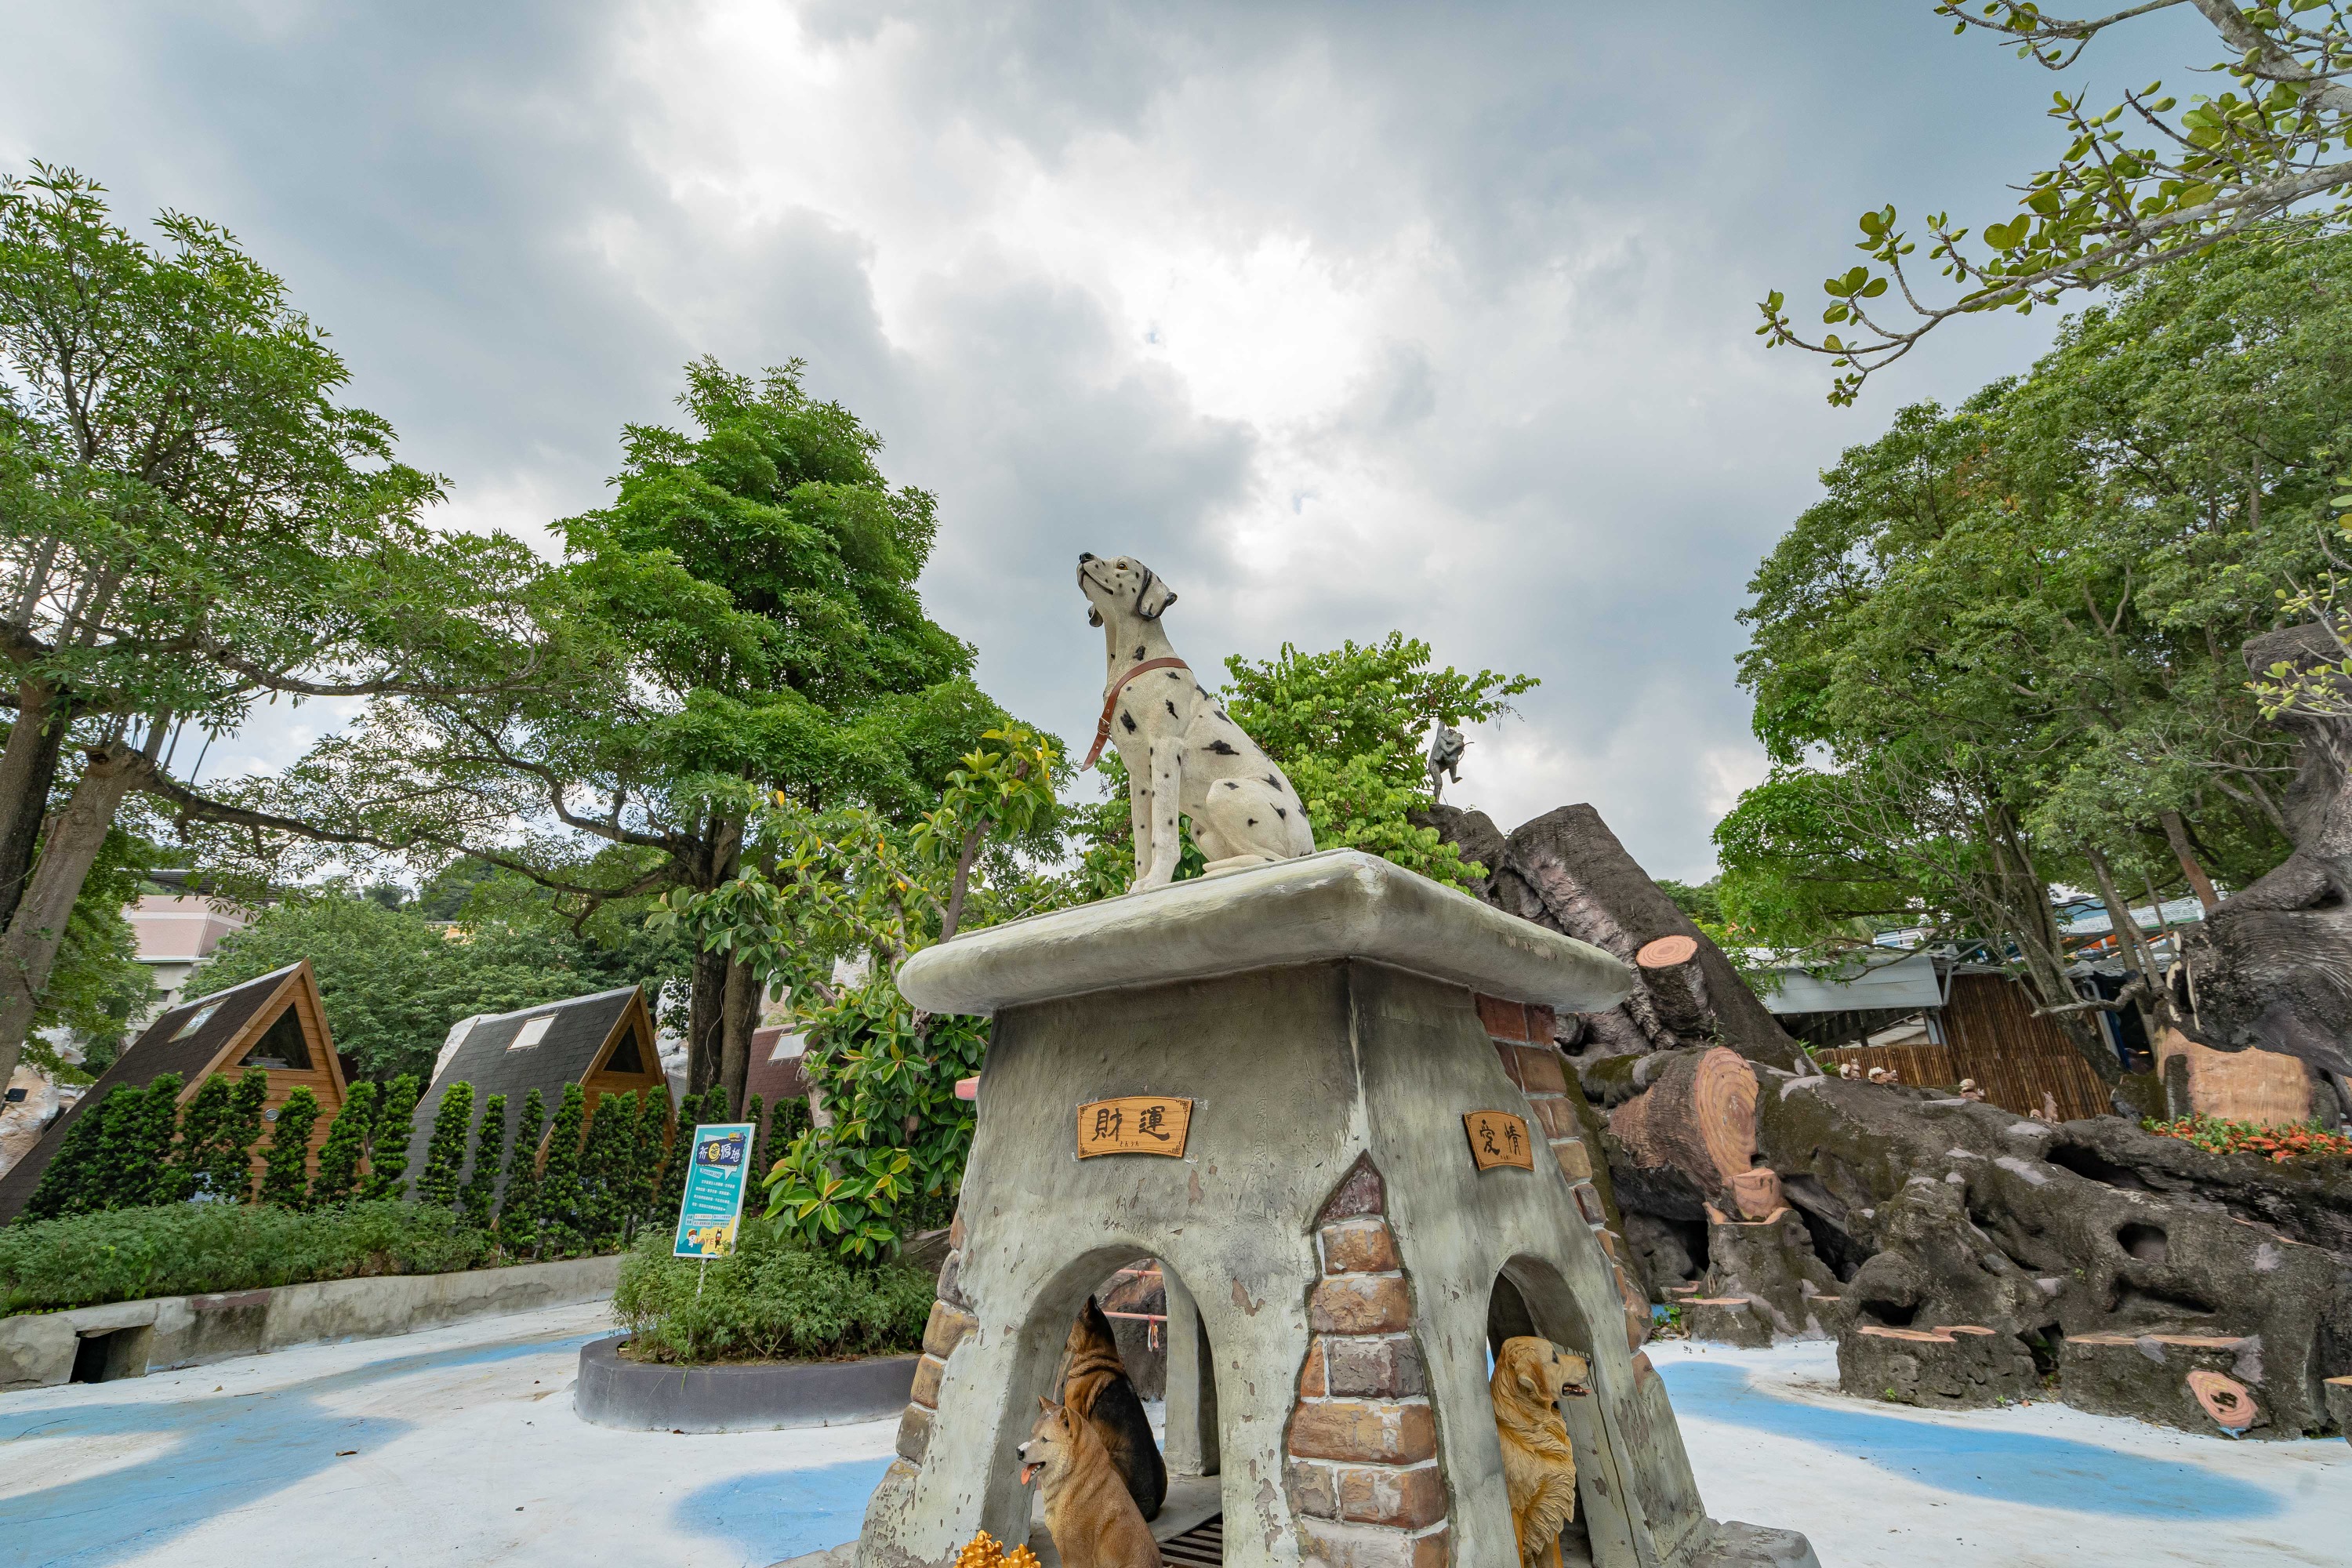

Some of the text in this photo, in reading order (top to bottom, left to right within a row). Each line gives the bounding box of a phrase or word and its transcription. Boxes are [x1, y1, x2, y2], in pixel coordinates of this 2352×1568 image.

[1091, 1105, 1170, 1142] 財運
[1479, 1119, 1522, 1156] 愛情
[699, 1143, 740, 1163] 祈福源地
